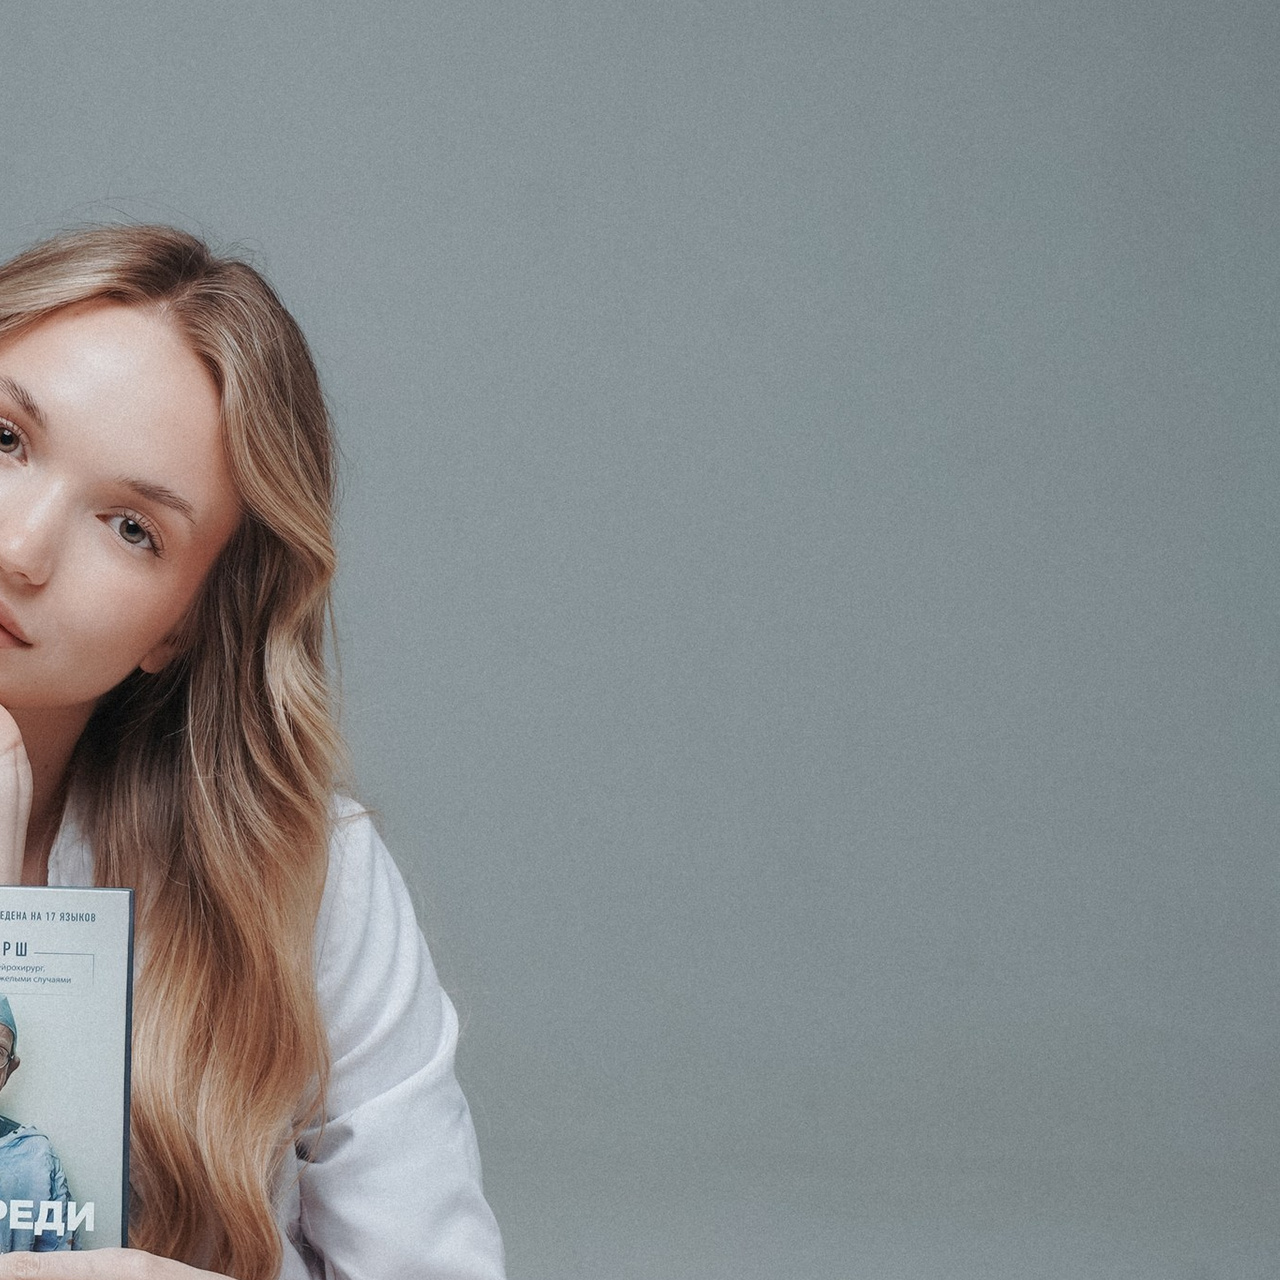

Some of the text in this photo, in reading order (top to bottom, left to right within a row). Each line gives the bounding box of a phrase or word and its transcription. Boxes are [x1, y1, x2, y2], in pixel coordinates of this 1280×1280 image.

[30, 911, 42, 921] НА
[46, 912, 56, 921] 17
[59, 912, 96, 922] ЯЗЫКОВ
[33, 976, 72, 984] случаями
